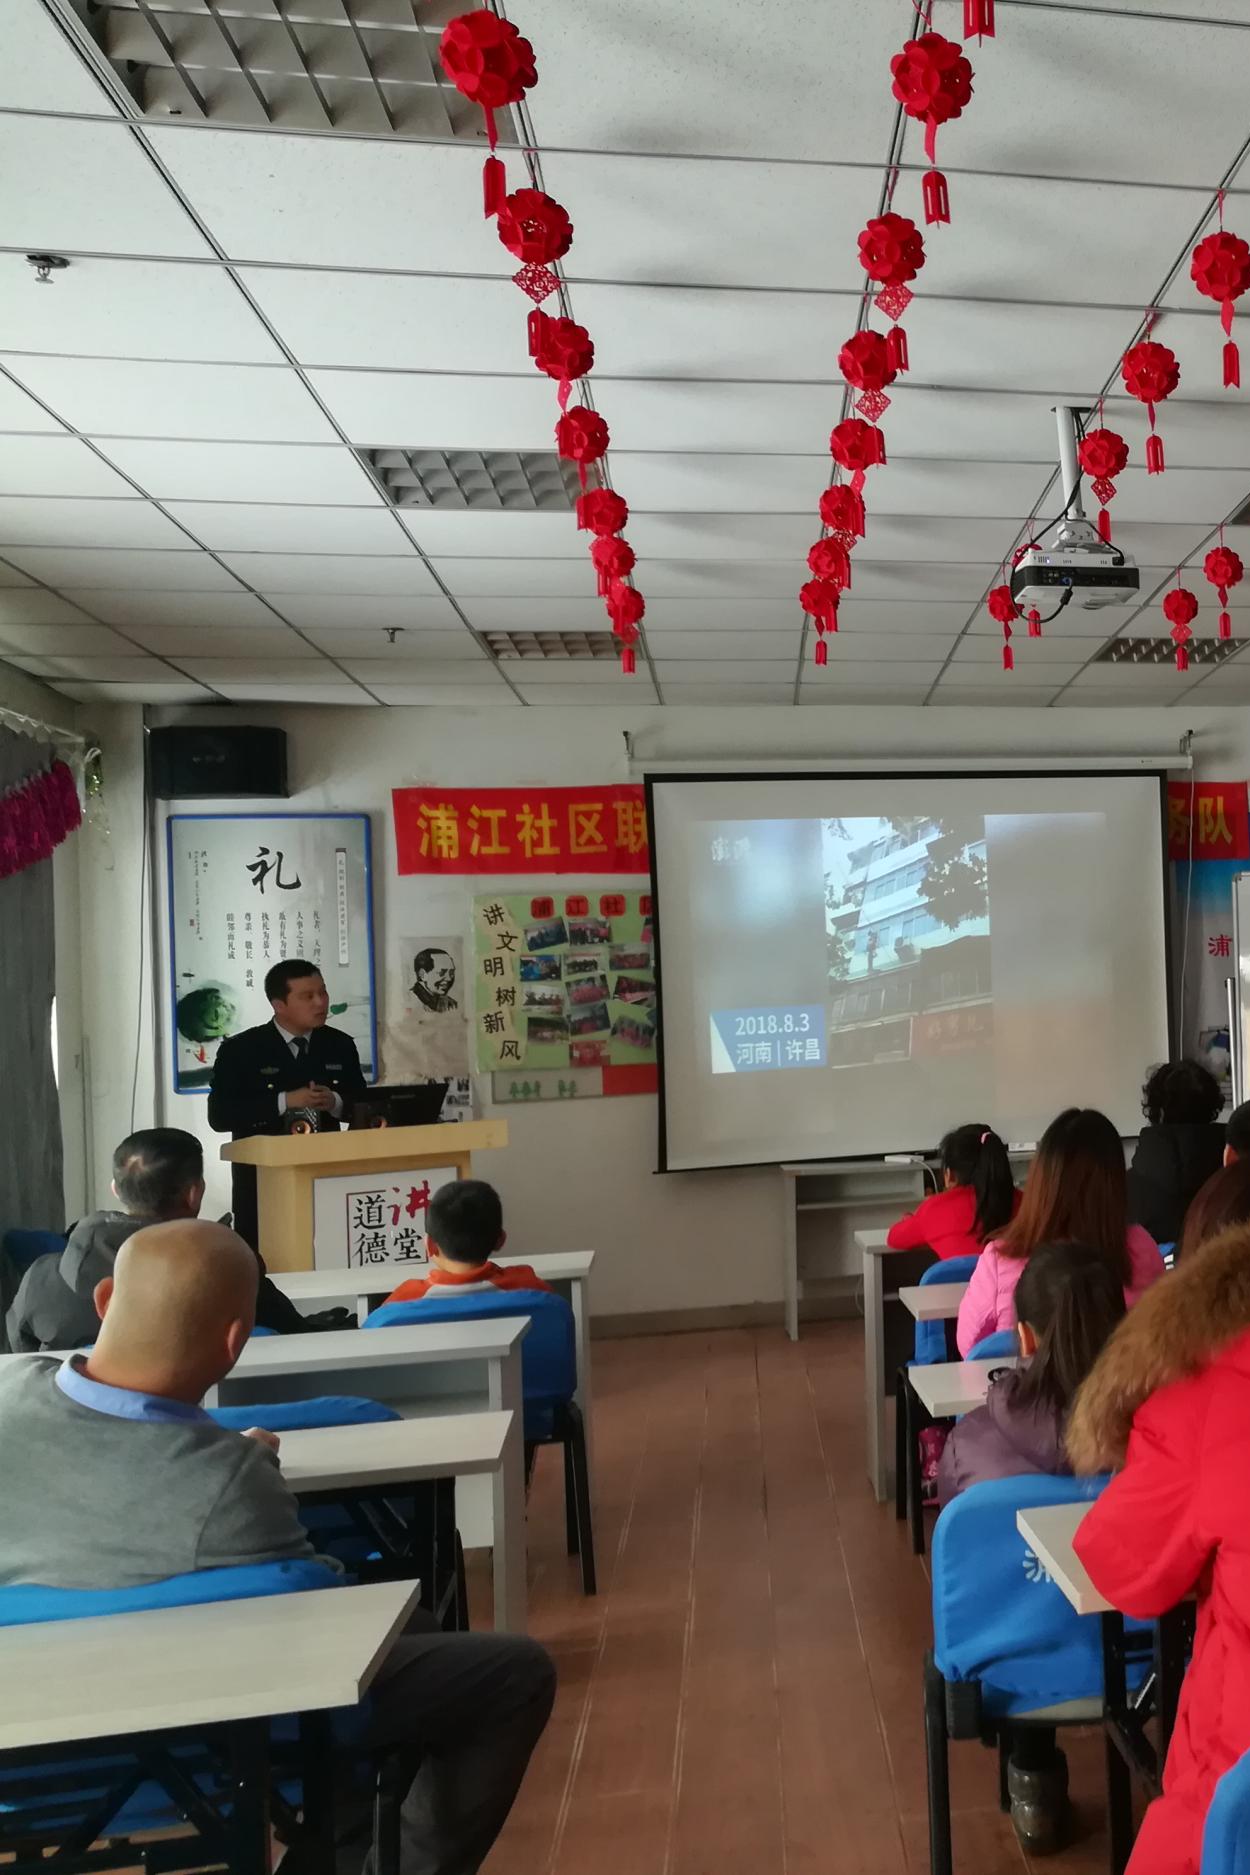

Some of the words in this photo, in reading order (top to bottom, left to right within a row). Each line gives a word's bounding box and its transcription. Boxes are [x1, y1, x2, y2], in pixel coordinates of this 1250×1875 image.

[246, 846, 301, 894] 礼
[1208, 934, 1233, 957] 浦
[483, 903, 522, 1060] 讲文明树新风
[735, 1013, 810, 1036] 2018.8.3
[353, 1194, 389, 1267] 道德
